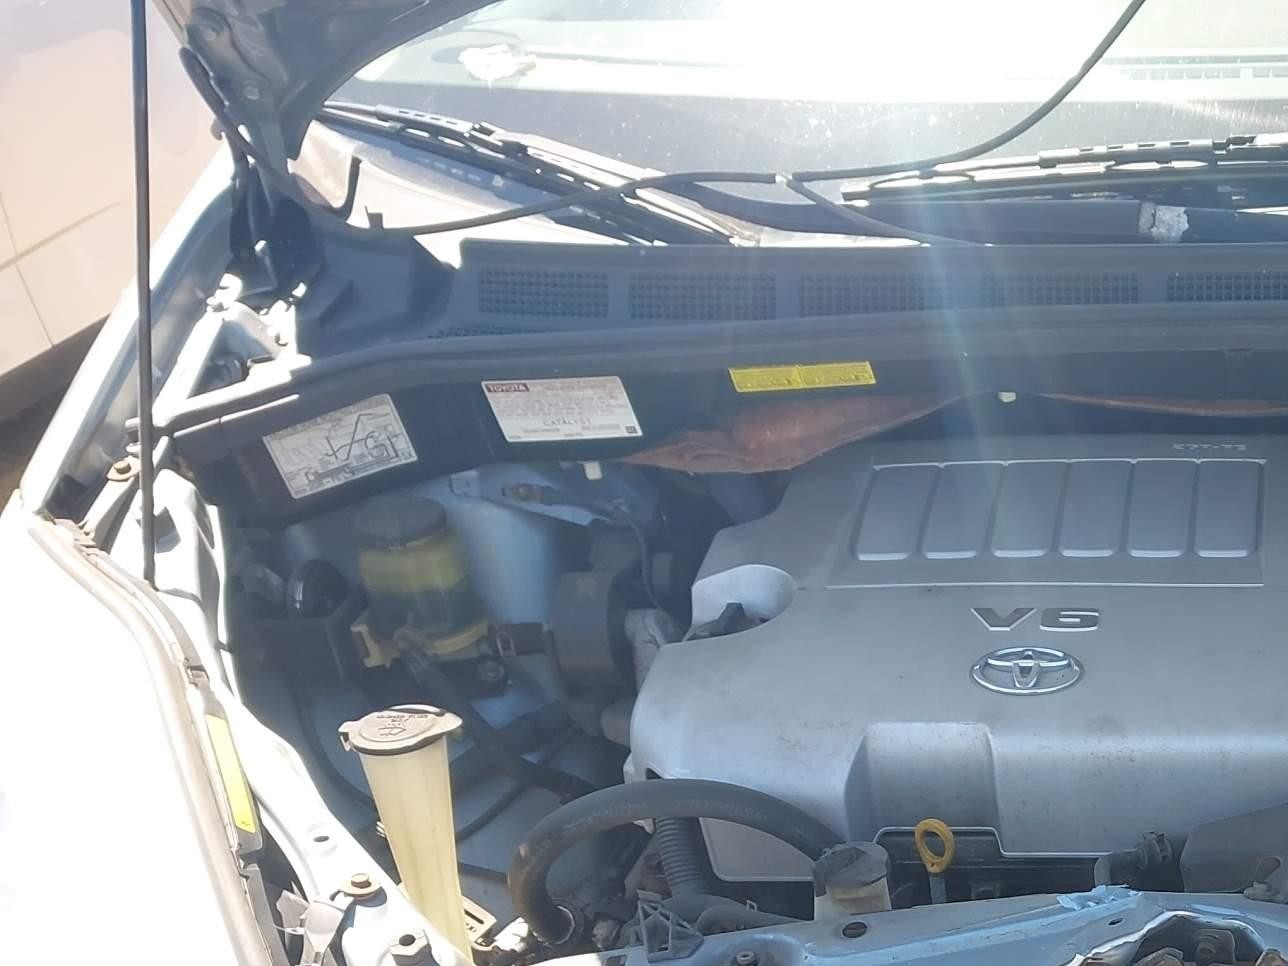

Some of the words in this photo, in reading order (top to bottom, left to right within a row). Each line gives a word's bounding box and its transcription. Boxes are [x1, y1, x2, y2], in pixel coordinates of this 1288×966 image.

[488, 383, 527, 392] TOYOTA
[543, 417, 592, 427] CATALYST
[970, 607, 1100, 632] V6
